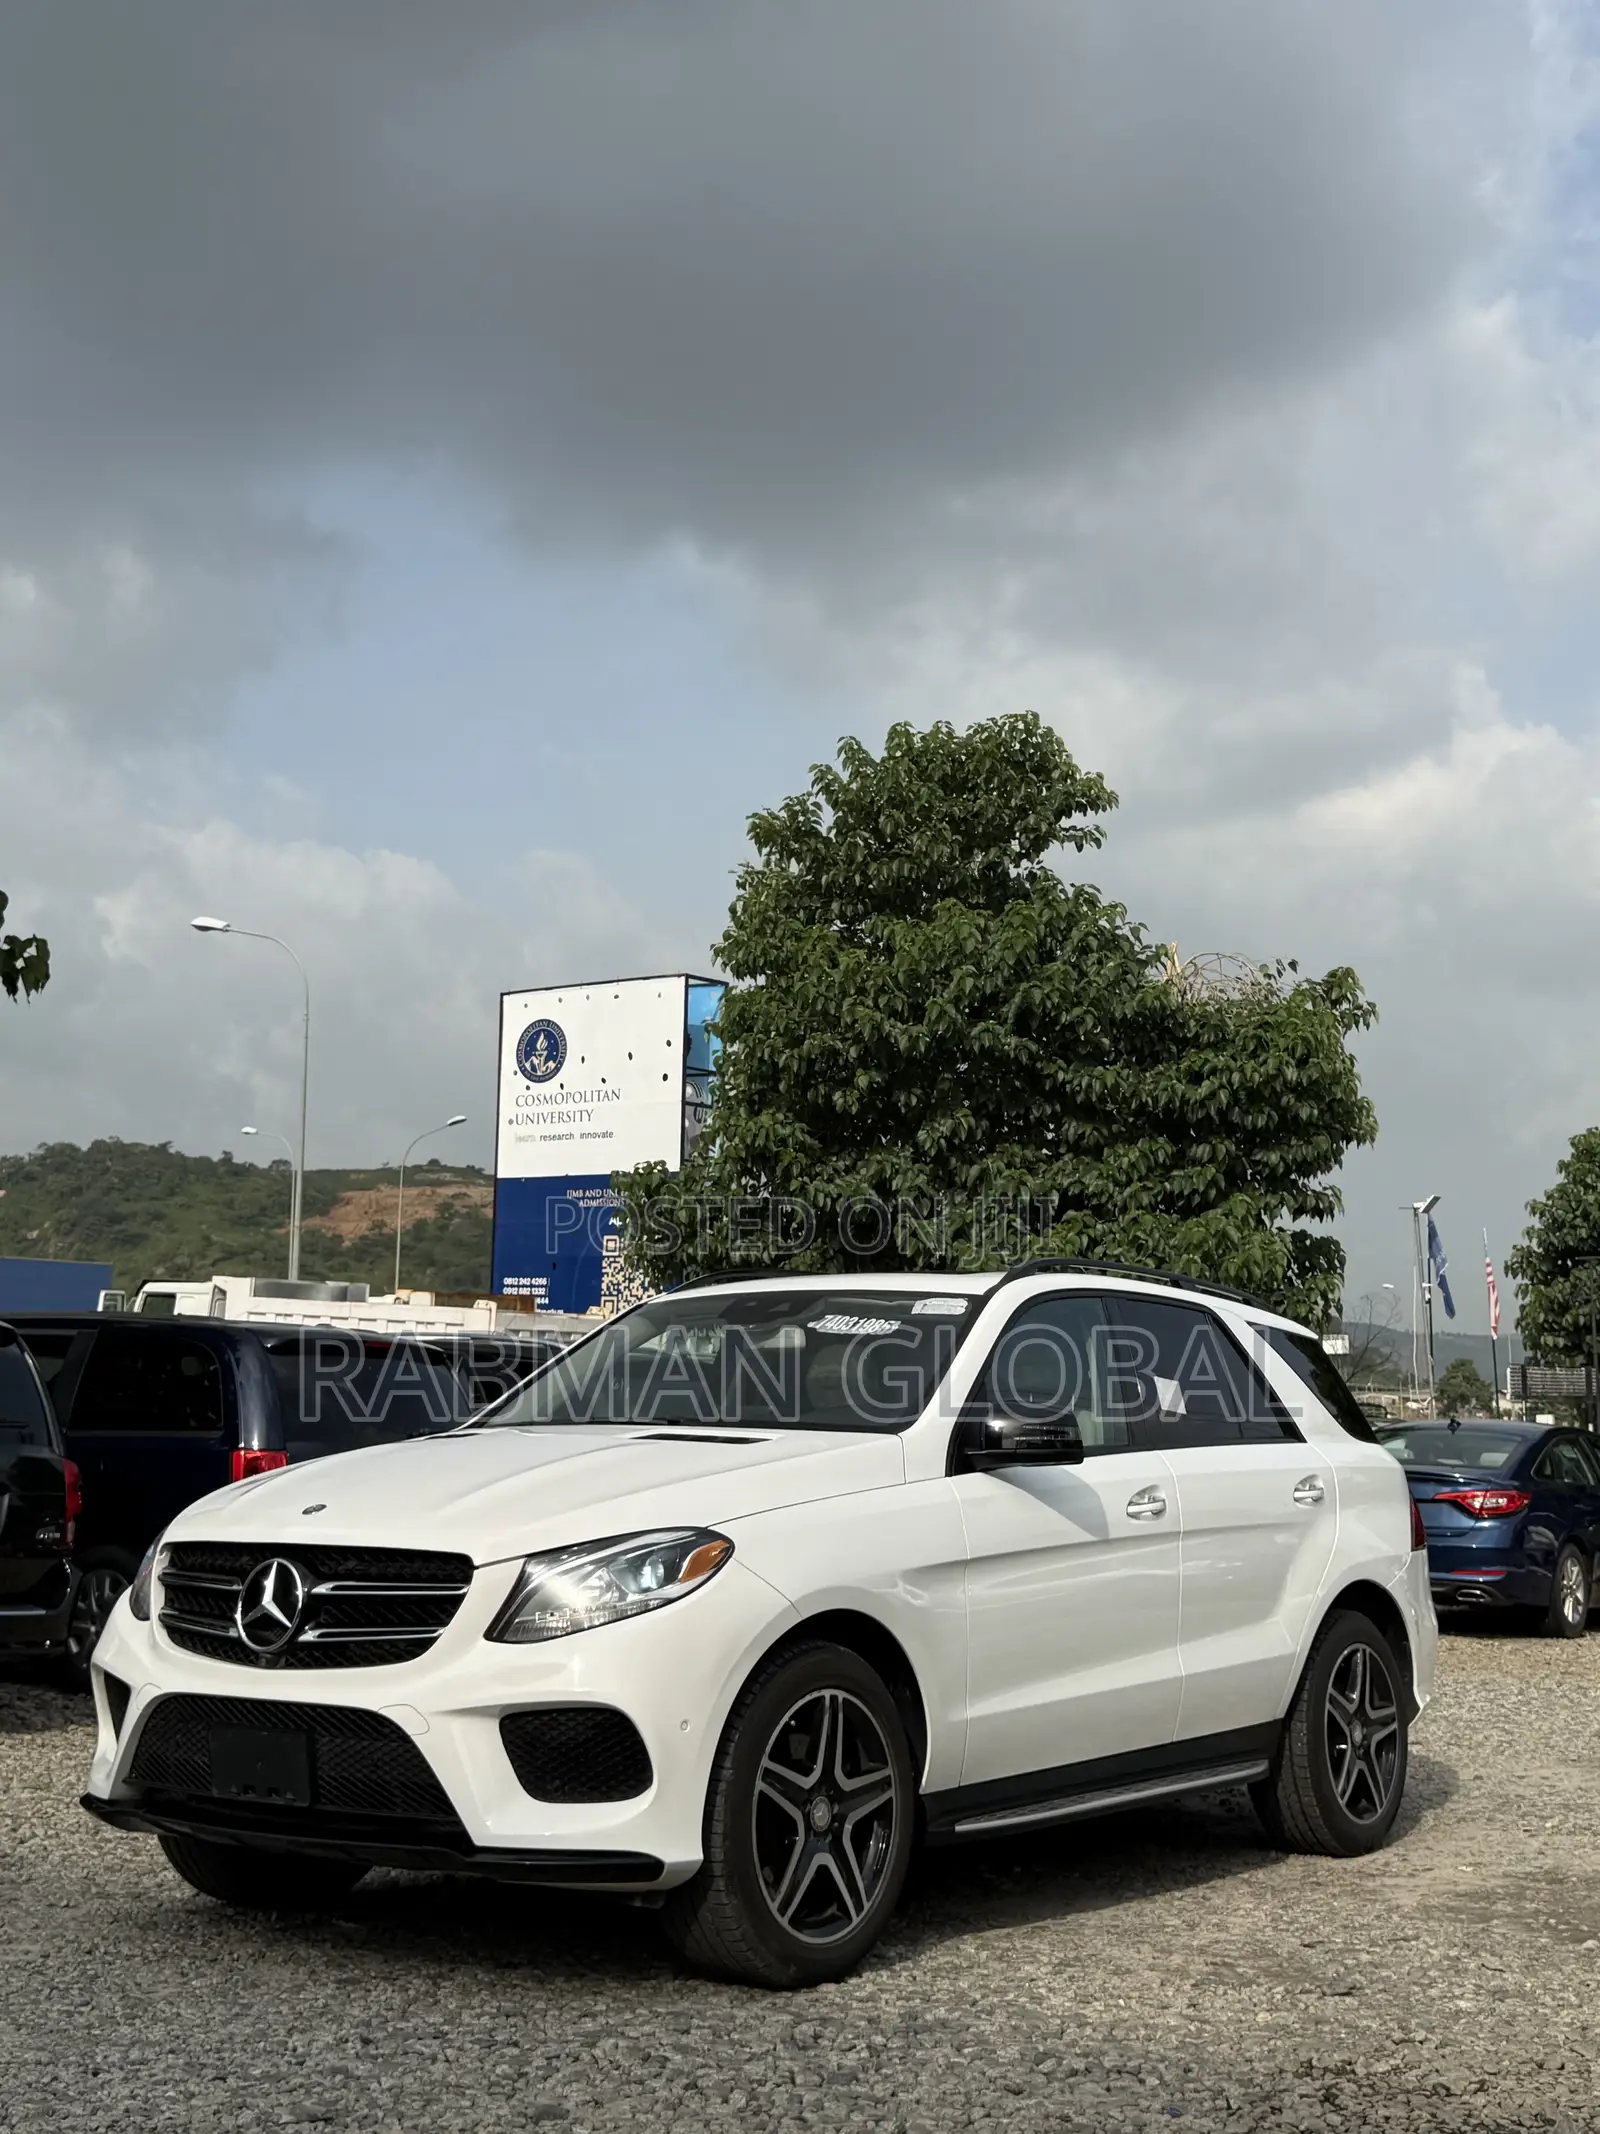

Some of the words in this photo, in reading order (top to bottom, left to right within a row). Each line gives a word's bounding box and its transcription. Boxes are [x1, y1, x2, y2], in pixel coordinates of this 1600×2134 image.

[515, 1088, 621, 1107] COSMOPOLITAN
[515, 1109, 594, 1126] UNIVERSITY
[585, 1189, 602, 1198] AND
[579, 1198, 625, 1207] ADMISSIONS
